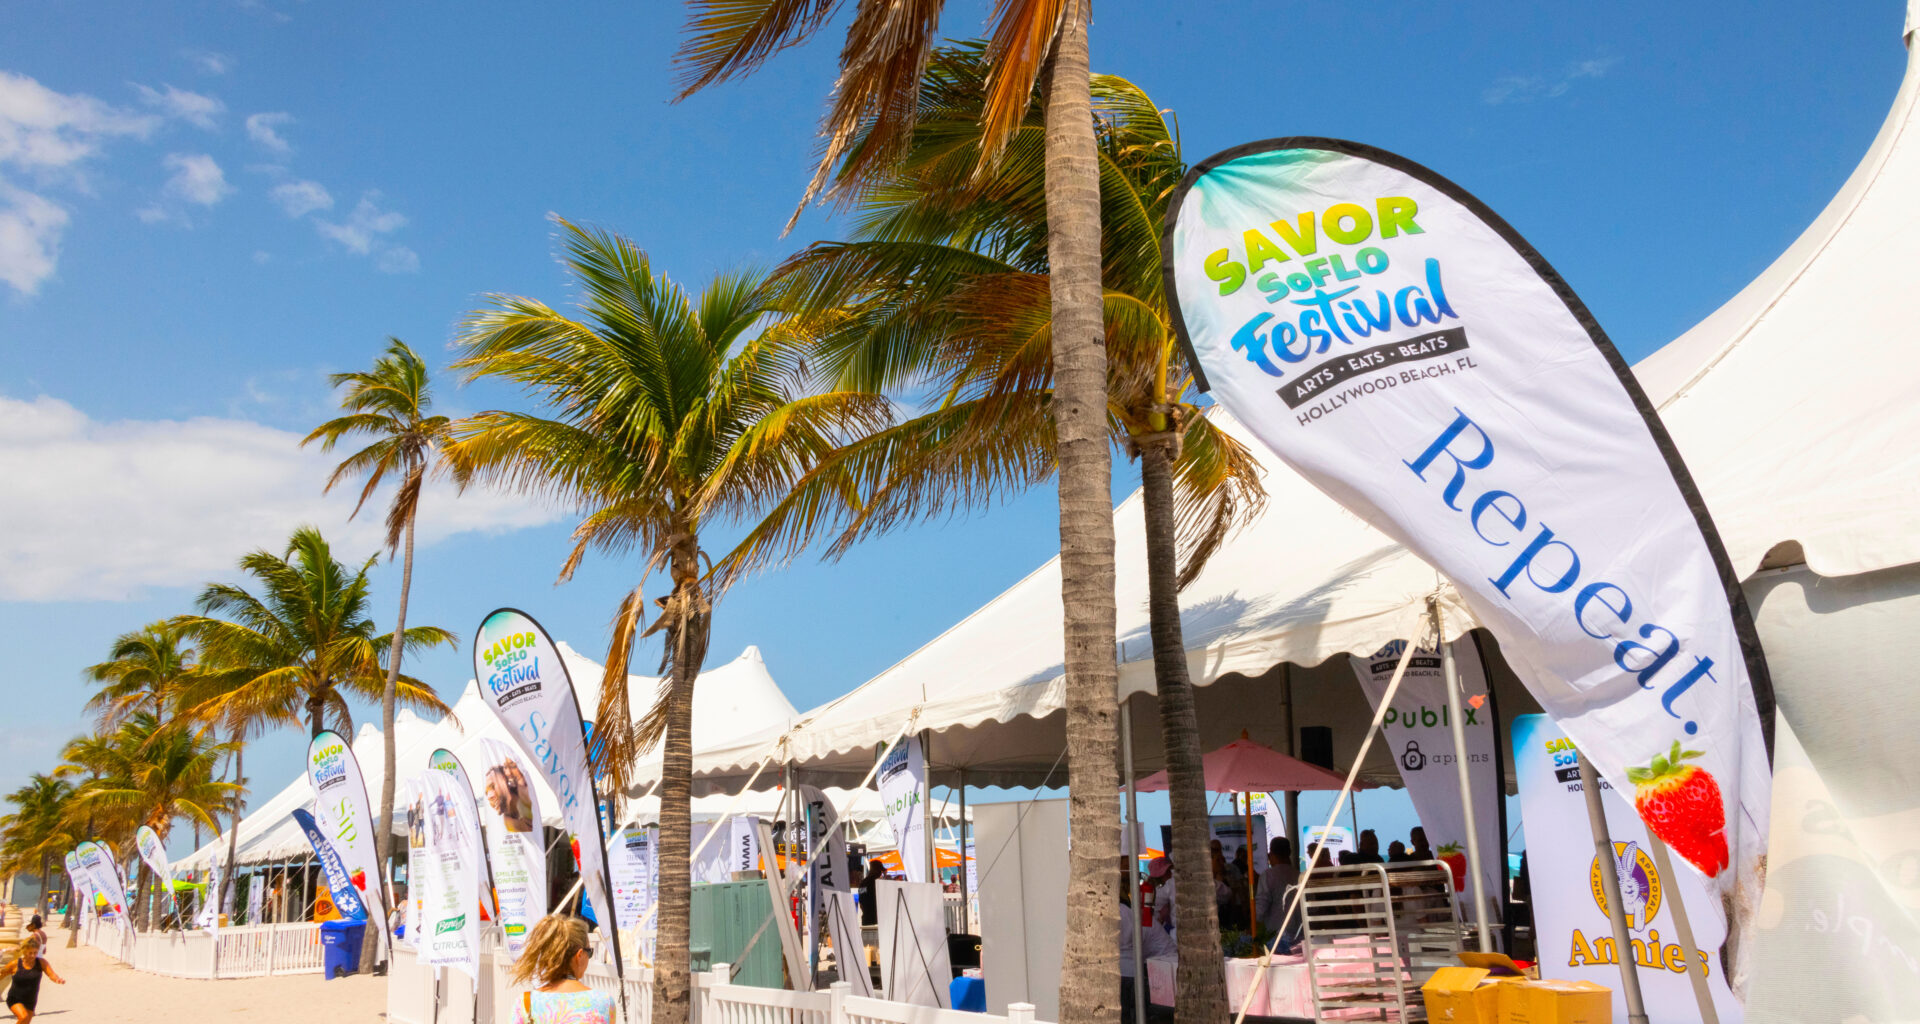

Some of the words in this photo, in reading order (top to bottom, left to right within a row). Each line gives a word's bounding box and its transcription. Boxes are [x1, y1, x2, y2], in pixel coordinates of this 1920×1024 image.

[1204, 196, 1426, 296] SAVOR
[1256, 246, 1390, 304] SoFLO
[1230, 257, 1460, 377] Festival
[1295, 367, 1334, 399] ARTS
[1347, 350, 1386, 371] EATS
[1399, 335, 1448, 357] BEATS
[1296, 376, 1397, 427] HOLLYWOOD
[1400, 362, 1456, 384] BEACH,
[1456, 356, 1478, 371] FL
[1402, 406, 1717, 735] Repeat.
[483, 631, 536, 666] SAVOR
[488, 656, 540, 696] Festival
[1382, 704, 1478, 730] Publx
[313, 744, 343, 765] SAVOR
[315, 760, 345, 784] Festival
[1432, 753, 1489, 766] aprns
[1639, 856, 1659, 912] APPROVAL
